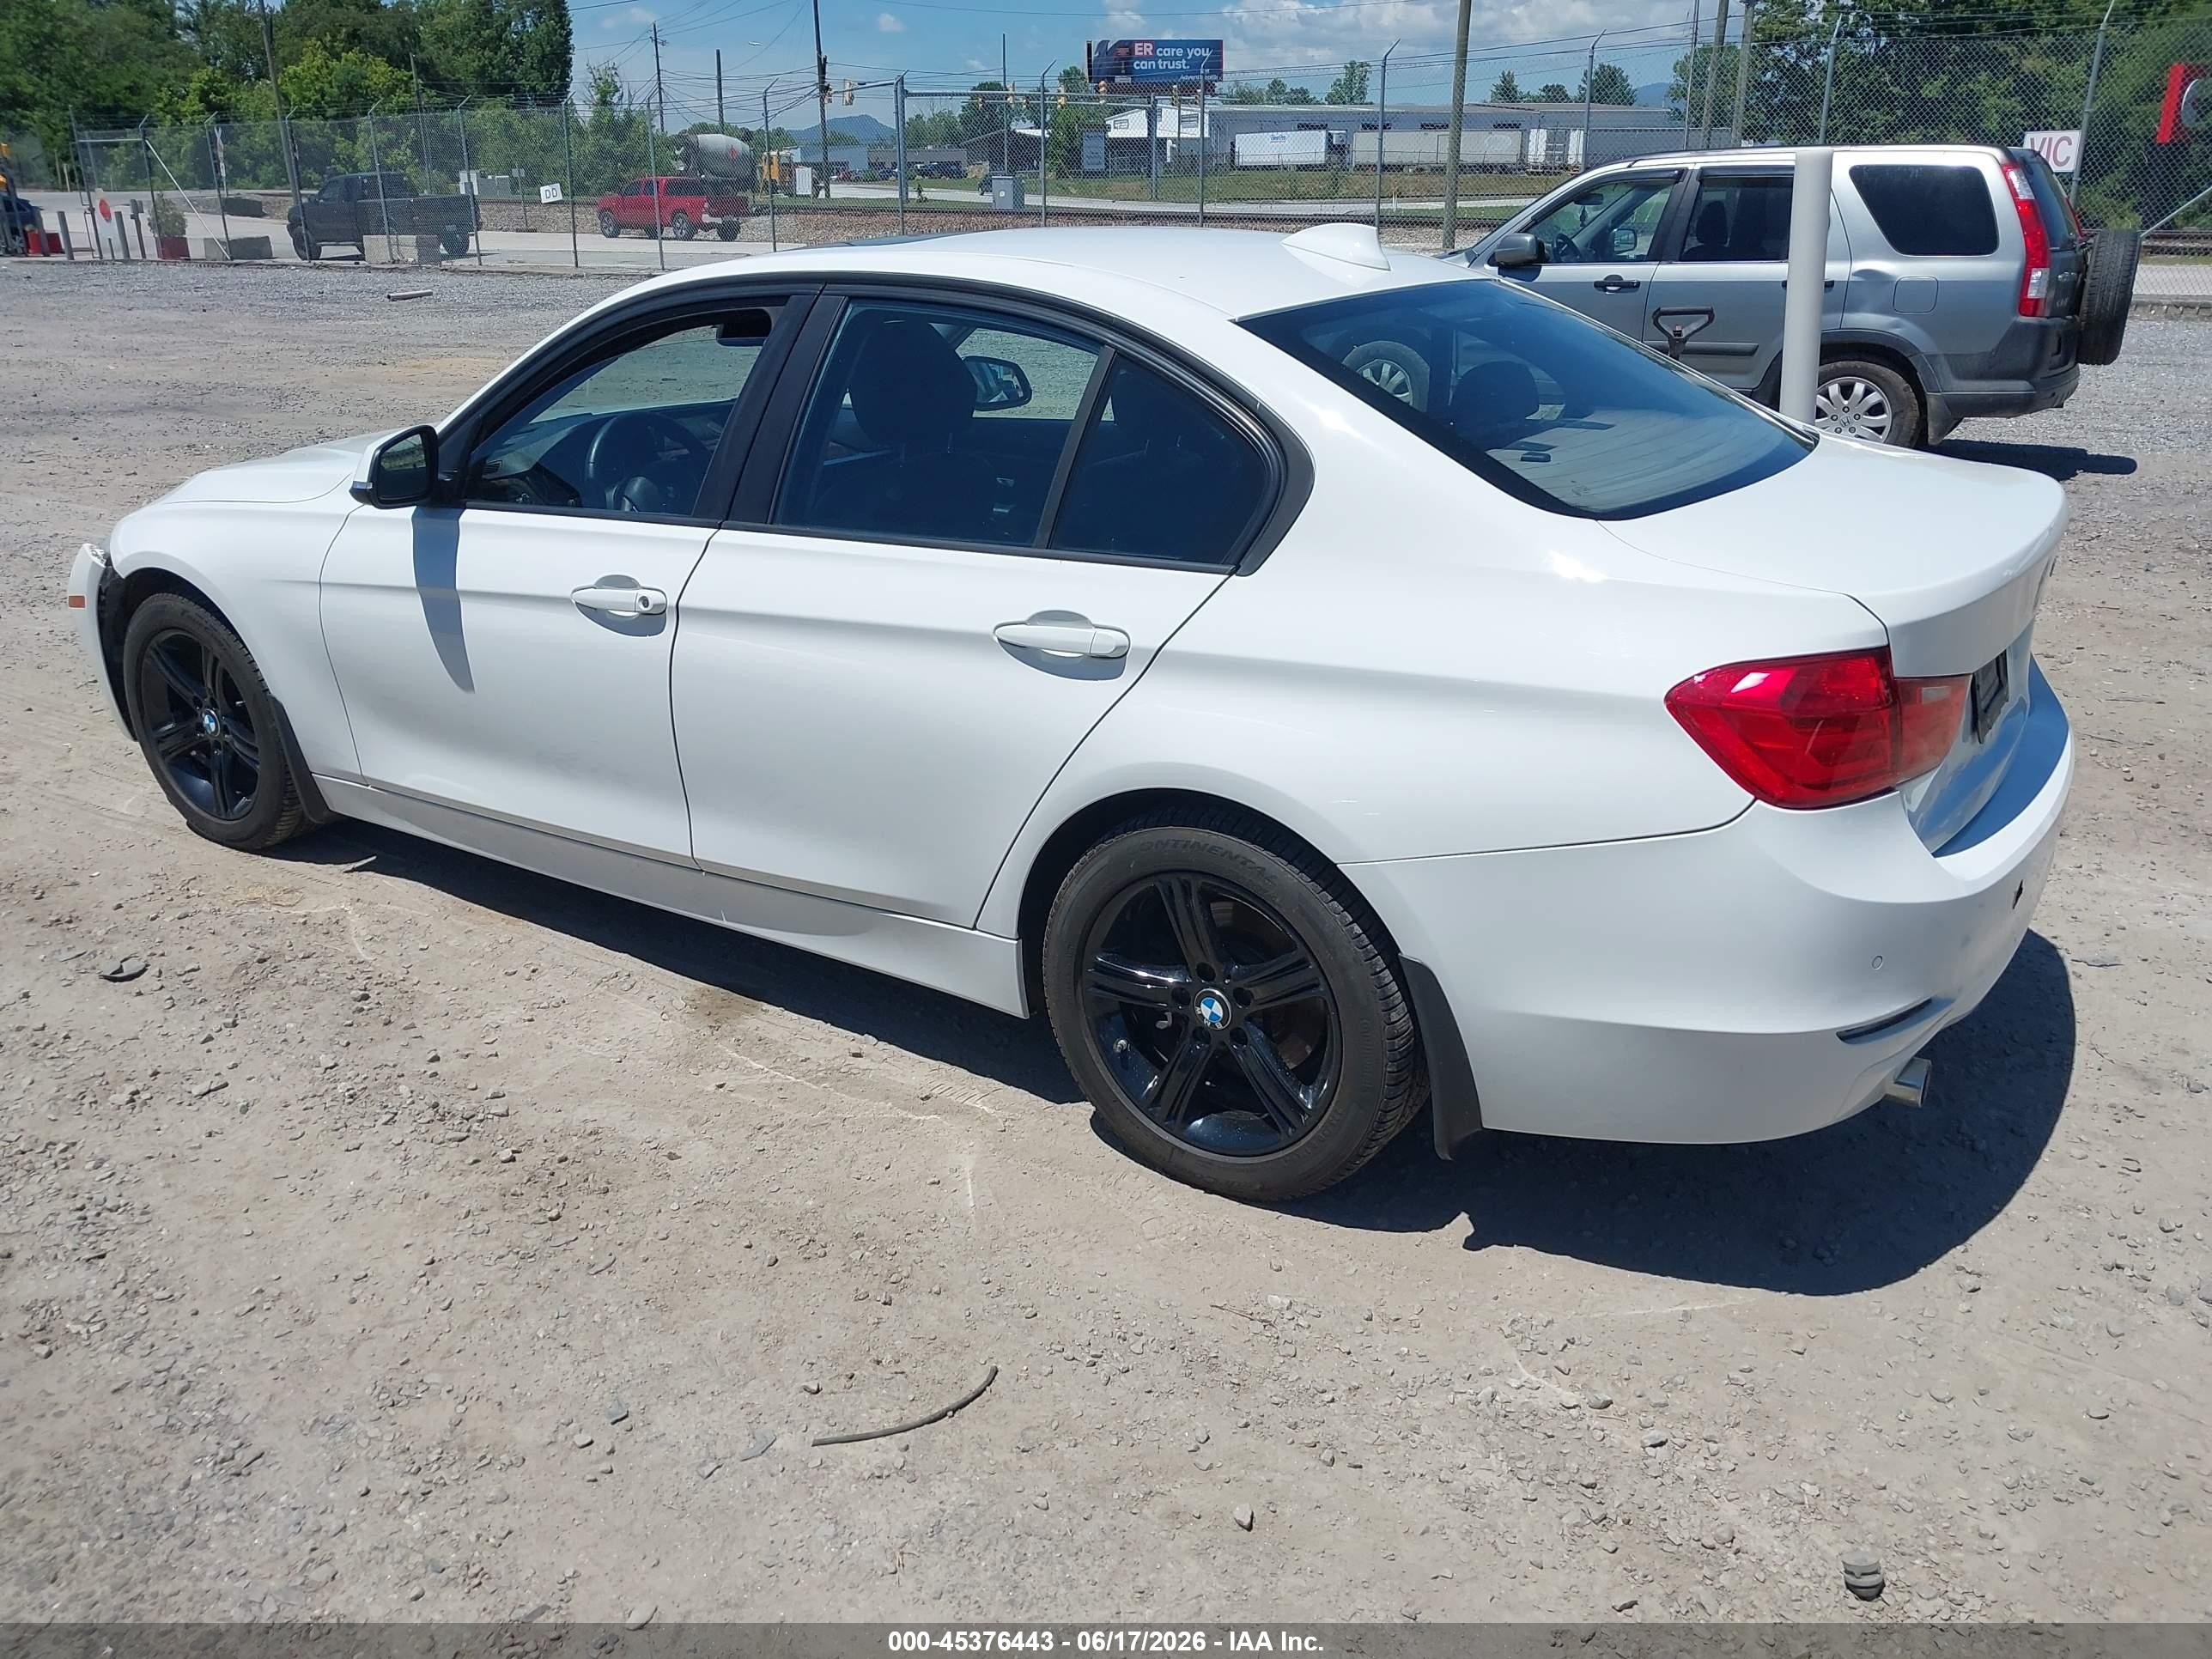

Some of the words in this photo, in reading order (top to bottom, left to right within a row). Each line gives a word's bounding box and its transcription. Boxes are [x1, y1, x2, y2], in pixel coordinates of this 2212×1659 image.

[1134, 43, 1153, 56] ER
[1156, 47, 1183, 57] care
[1186, 48, 1210, 59] you
[1133, 60, 1156, 70] can
[1158, 58, 1190, 70] trust.
[544, 187, 558, 199] DD
